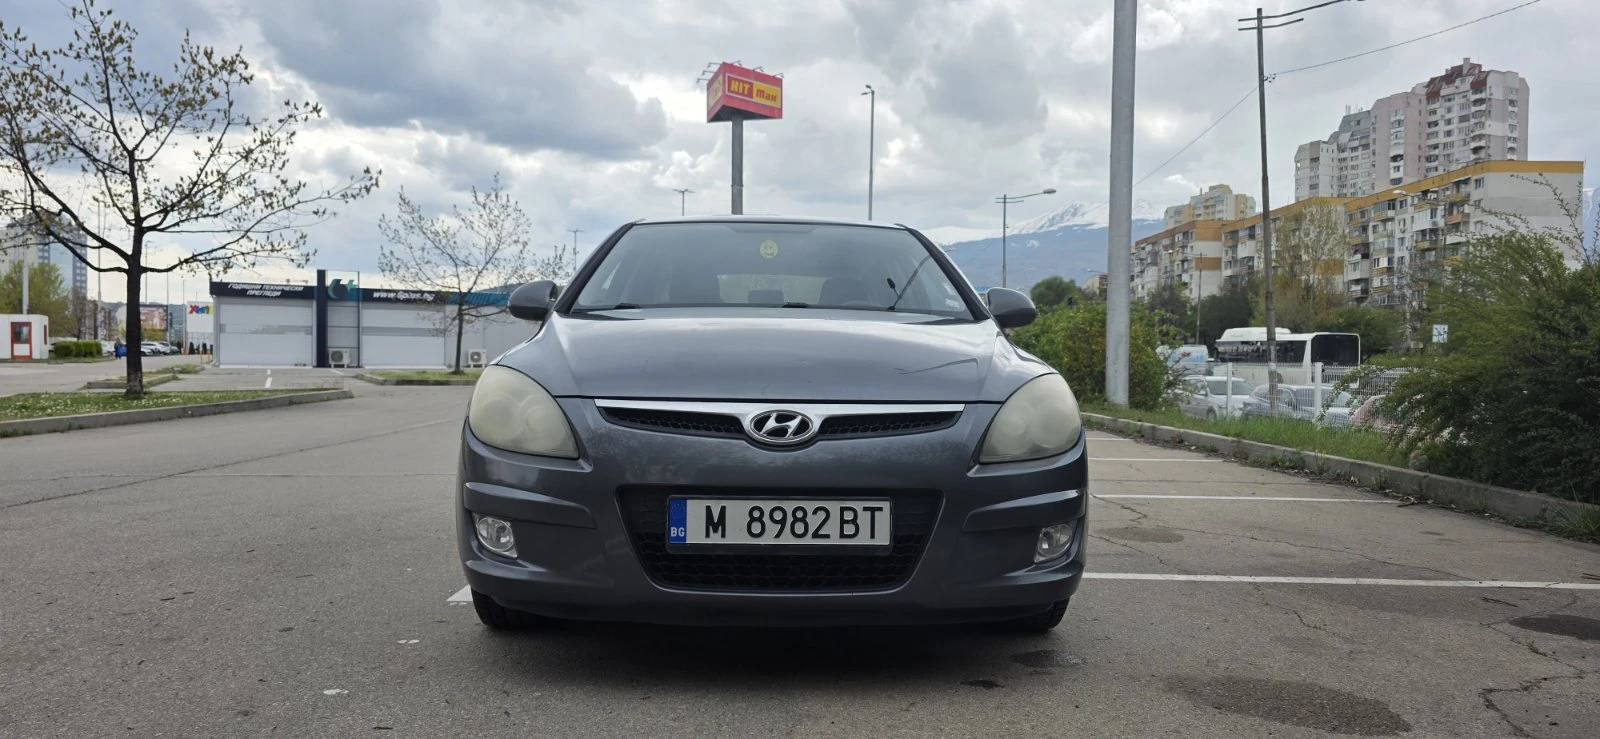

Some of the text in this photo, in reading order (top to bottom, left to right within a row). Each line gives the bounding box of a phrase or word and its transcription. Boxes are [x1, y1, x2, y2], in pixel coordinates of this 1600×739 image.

[731, 79, 750, 96] HIT
[705, 505, 884, 540] M 8982 BT
[670, 527, 685, 538] BG
